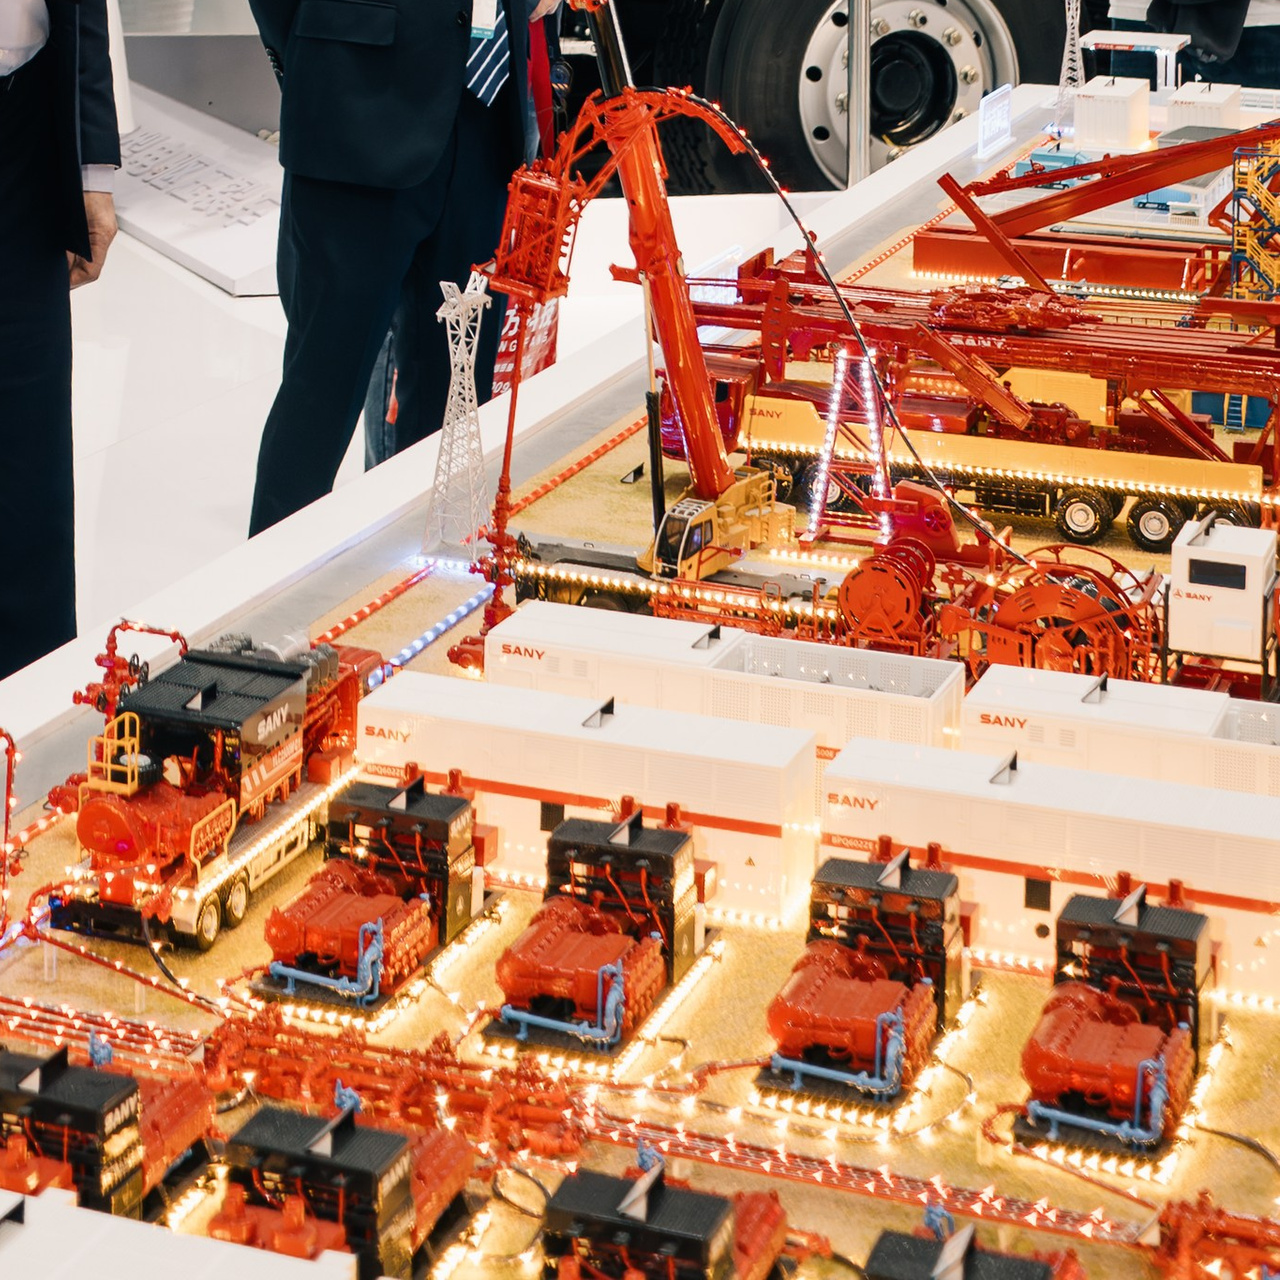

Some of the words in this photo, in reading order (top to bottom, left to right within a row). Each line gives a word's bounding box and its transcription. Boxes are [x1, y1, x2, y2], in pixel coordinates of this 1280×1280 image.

[950, 334, 1007, 350] SANY
[749, 408, 782, 419] SANY
[1185, 592, 1212, 602] SANY
[501, 643, 545, 661] SANY
[257, 703, 289, 741] SANY
[980, 713, 1027, 729] SANY
[364, 725, 411, 743] SANY
[827, 792, 878, 811] SANY
[104, 1092, 138, 1135] SANY
